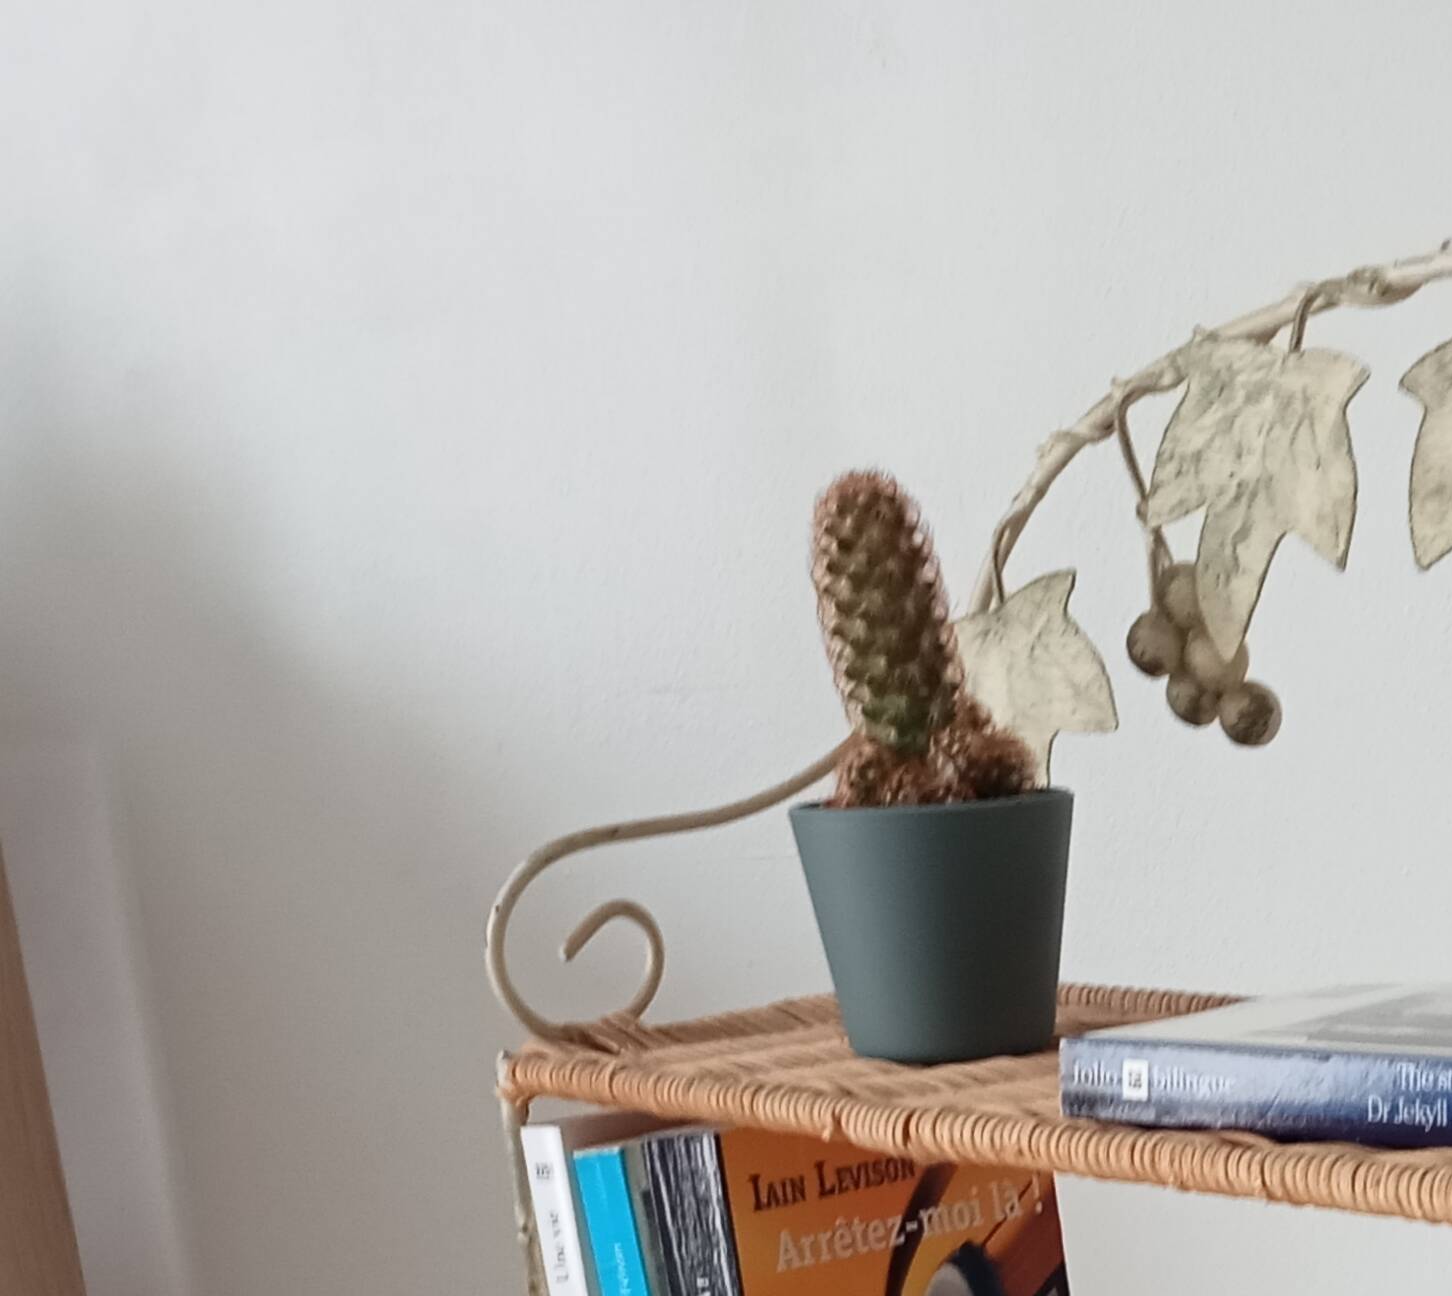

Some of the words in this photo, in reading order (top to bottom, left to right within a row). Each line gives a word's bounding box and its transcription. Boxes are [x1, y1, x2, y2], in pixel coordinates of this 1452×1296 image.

[1074, 1060, 1117, 1087] folio
[1153, 1064, 1234, 1097] bilingue
[1399, 1062, 1434, 1092] The
[1367, 1094, 1390, 1123] Dr
[1394, 1097, 1448, 1132] Jekyll
[777, 1185, 984, 1273] Arrêtez-moi
[990, 1177, 1022, 1223] là
